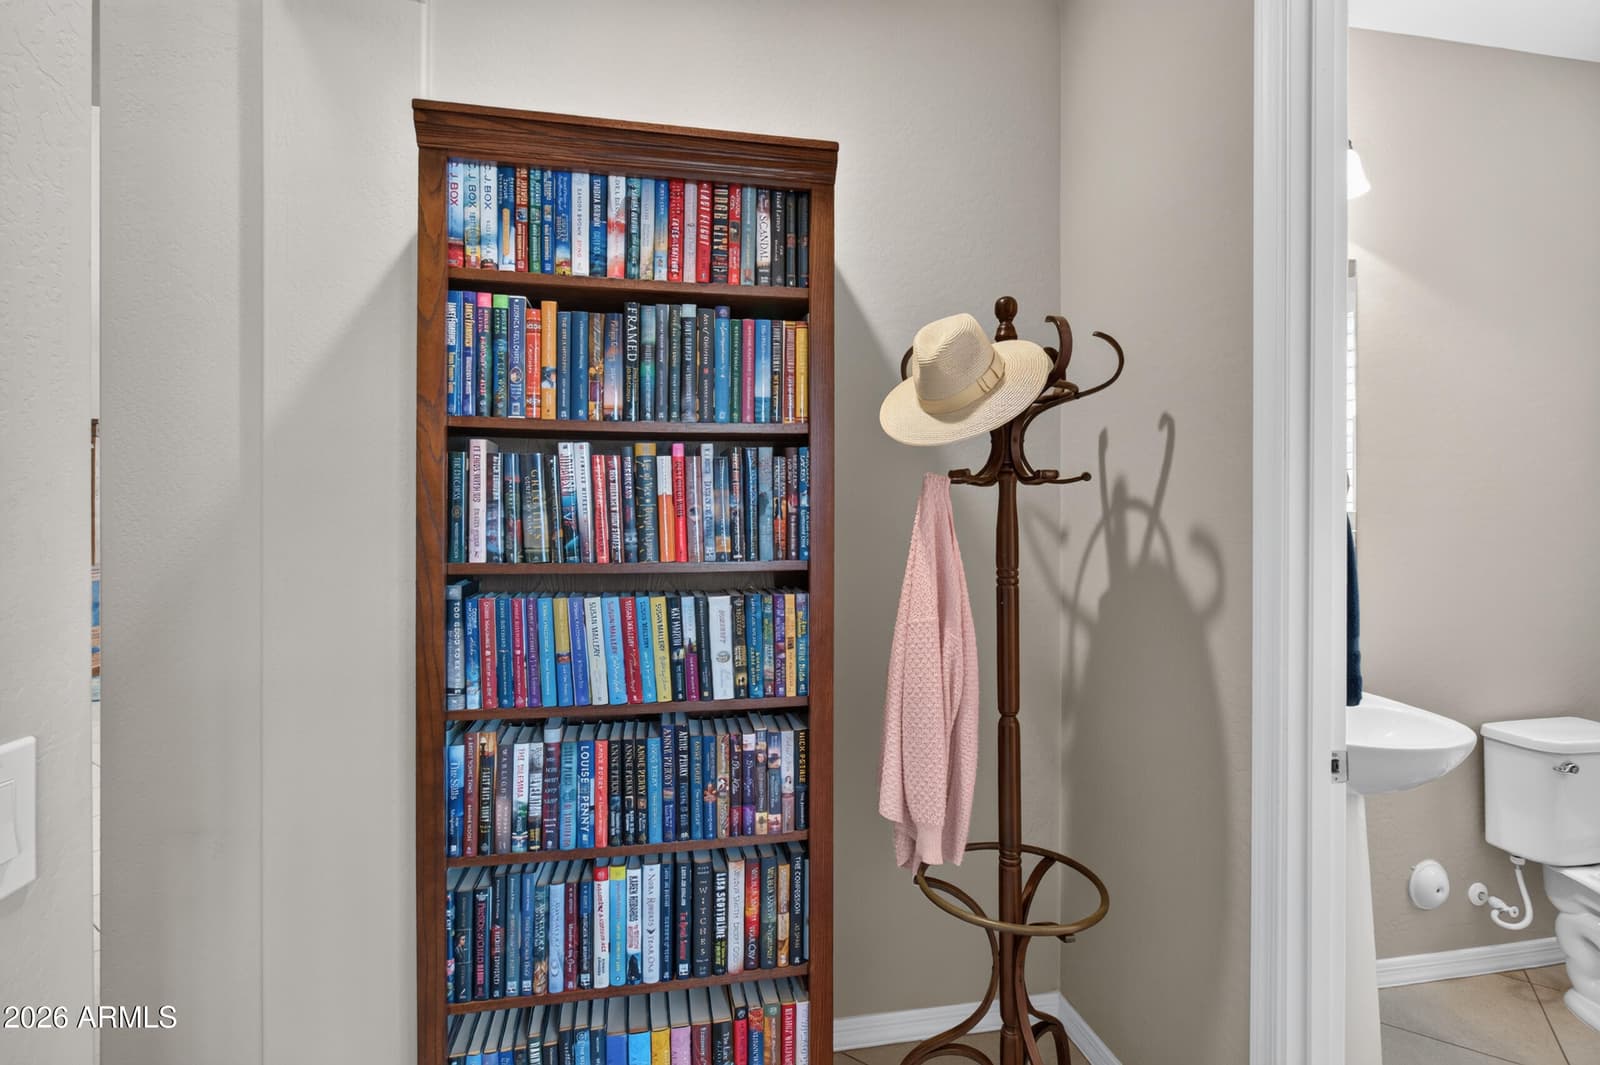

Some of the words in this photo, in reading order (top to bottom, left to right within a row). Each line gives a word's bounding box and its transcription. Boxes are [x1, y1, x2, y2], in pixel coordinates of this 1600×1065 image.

[450, 182, 458, 207] BOX
[484, 185, 492, 210] BOX
[700, 189, 709, 211] LAST
[714, 225, 728, 250] CITY
[759, 215, 768, 261] SCANDAL
[627, 307, 637, 362] FRAMED
[581, 746, 589, 784] LOUISE
[581, 796, 589, 832] PENNY
[716, 873, 726, 891] LISA
[647, 898, 656, 927] ROBERTS
[699, 887, 708, 954] WITCHES
[716, 892, 726, 939] SCOTTOLINE
